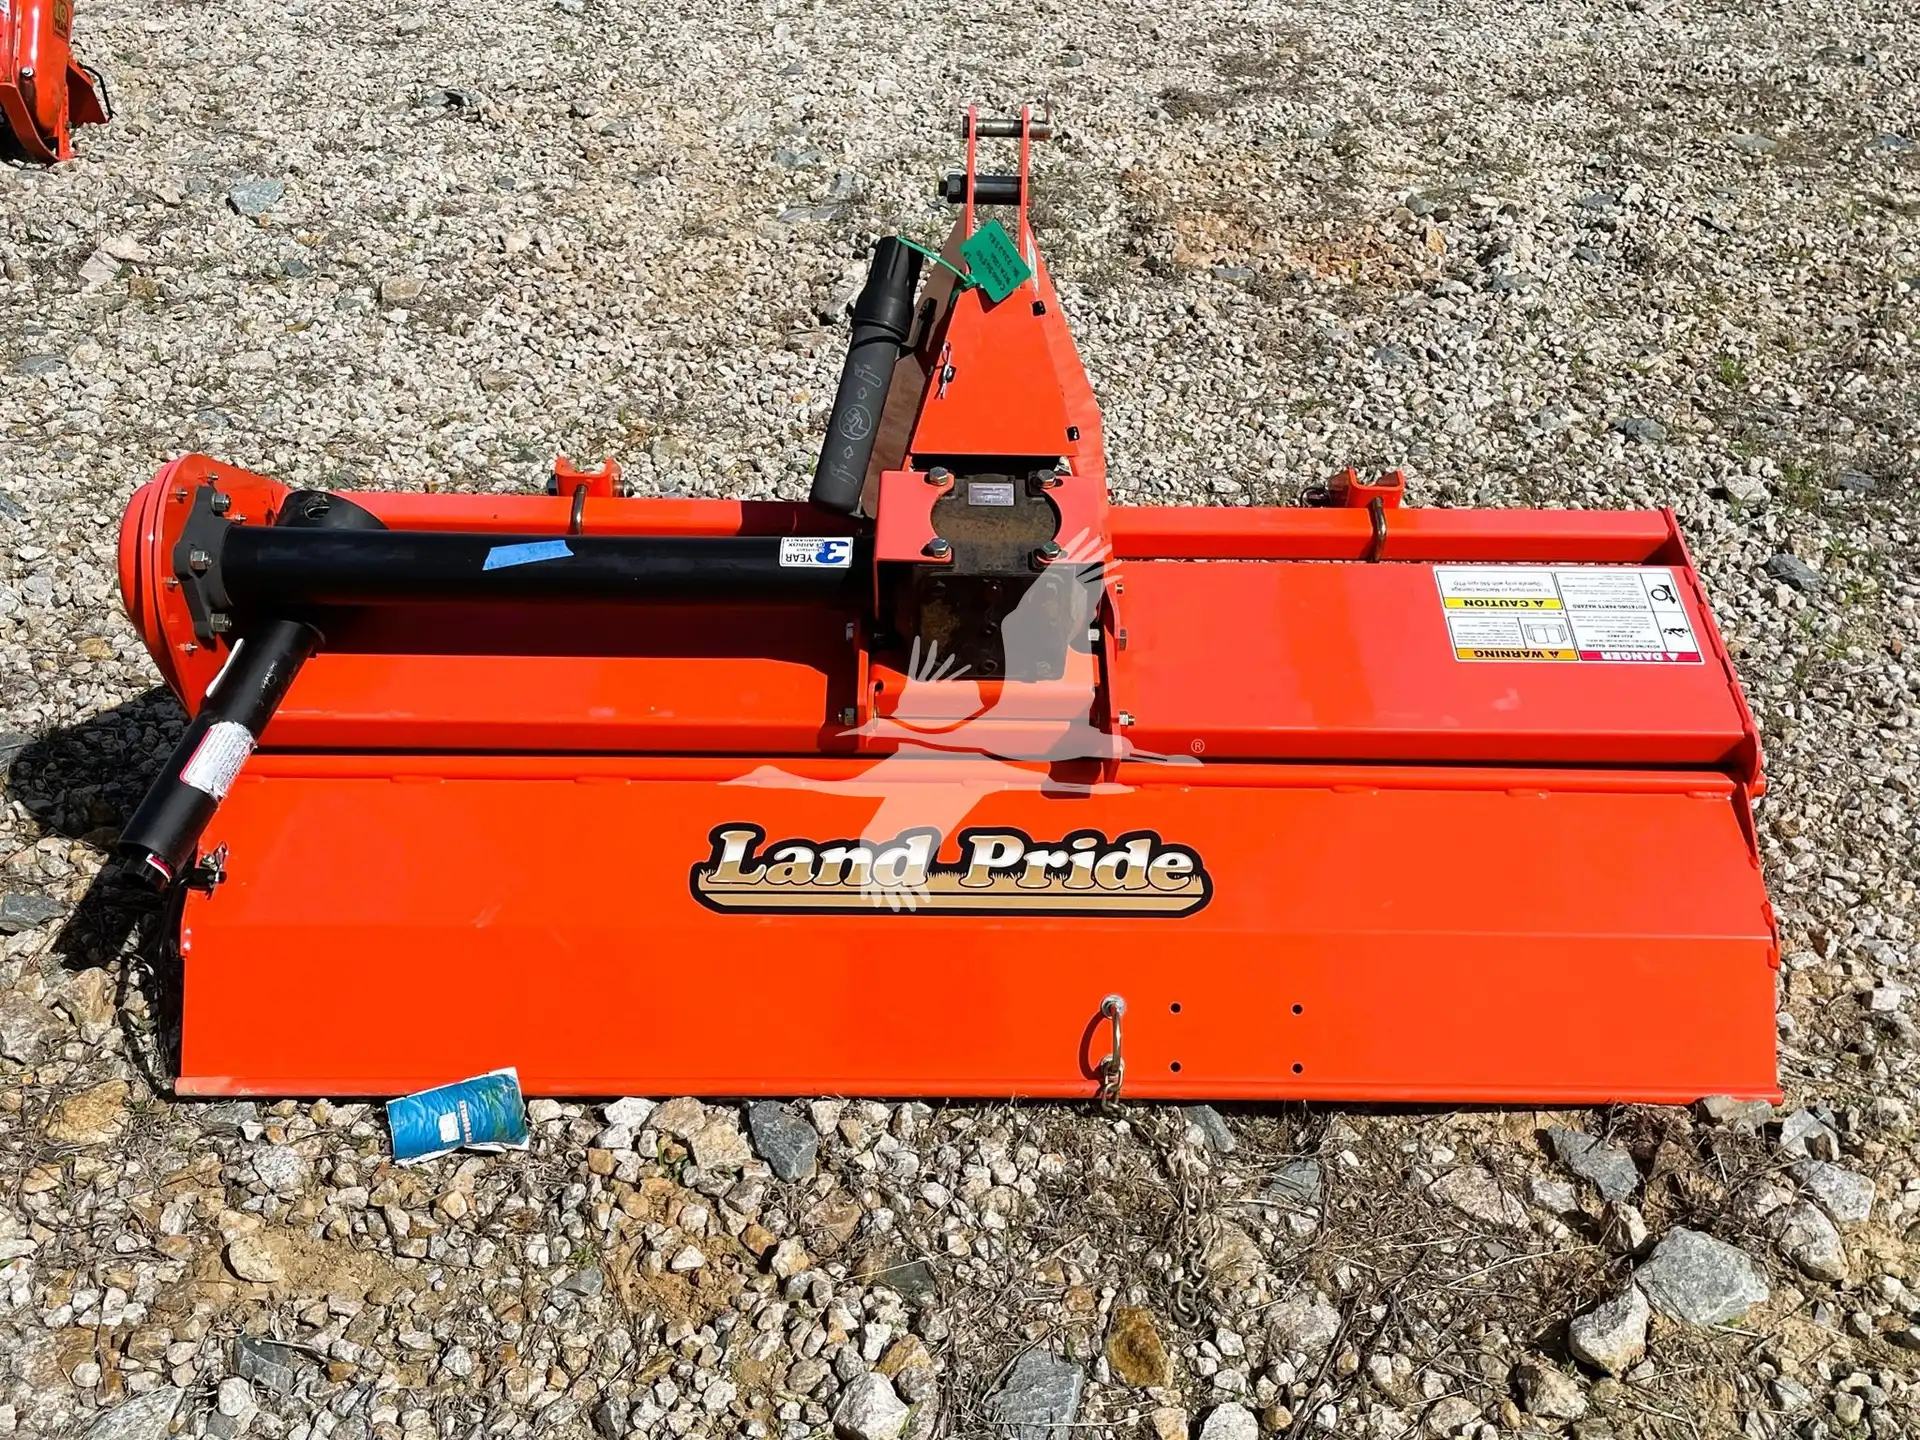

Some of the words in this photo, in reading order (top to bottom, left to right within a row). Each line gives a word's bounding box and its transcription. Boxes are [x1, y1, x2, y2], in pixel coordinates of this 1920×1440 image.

[815, 540, 849, 563] 3
[785, 553, 813, 562] YEAR
[1463, 599, 1529, 607] CAUTION
[1473, 650, 1544, 658] WARNING
[1600, 652, 1664, 660] DANGER
[706, 828, 933, 887] Land
[958, 833, 1196, 891] Pride
